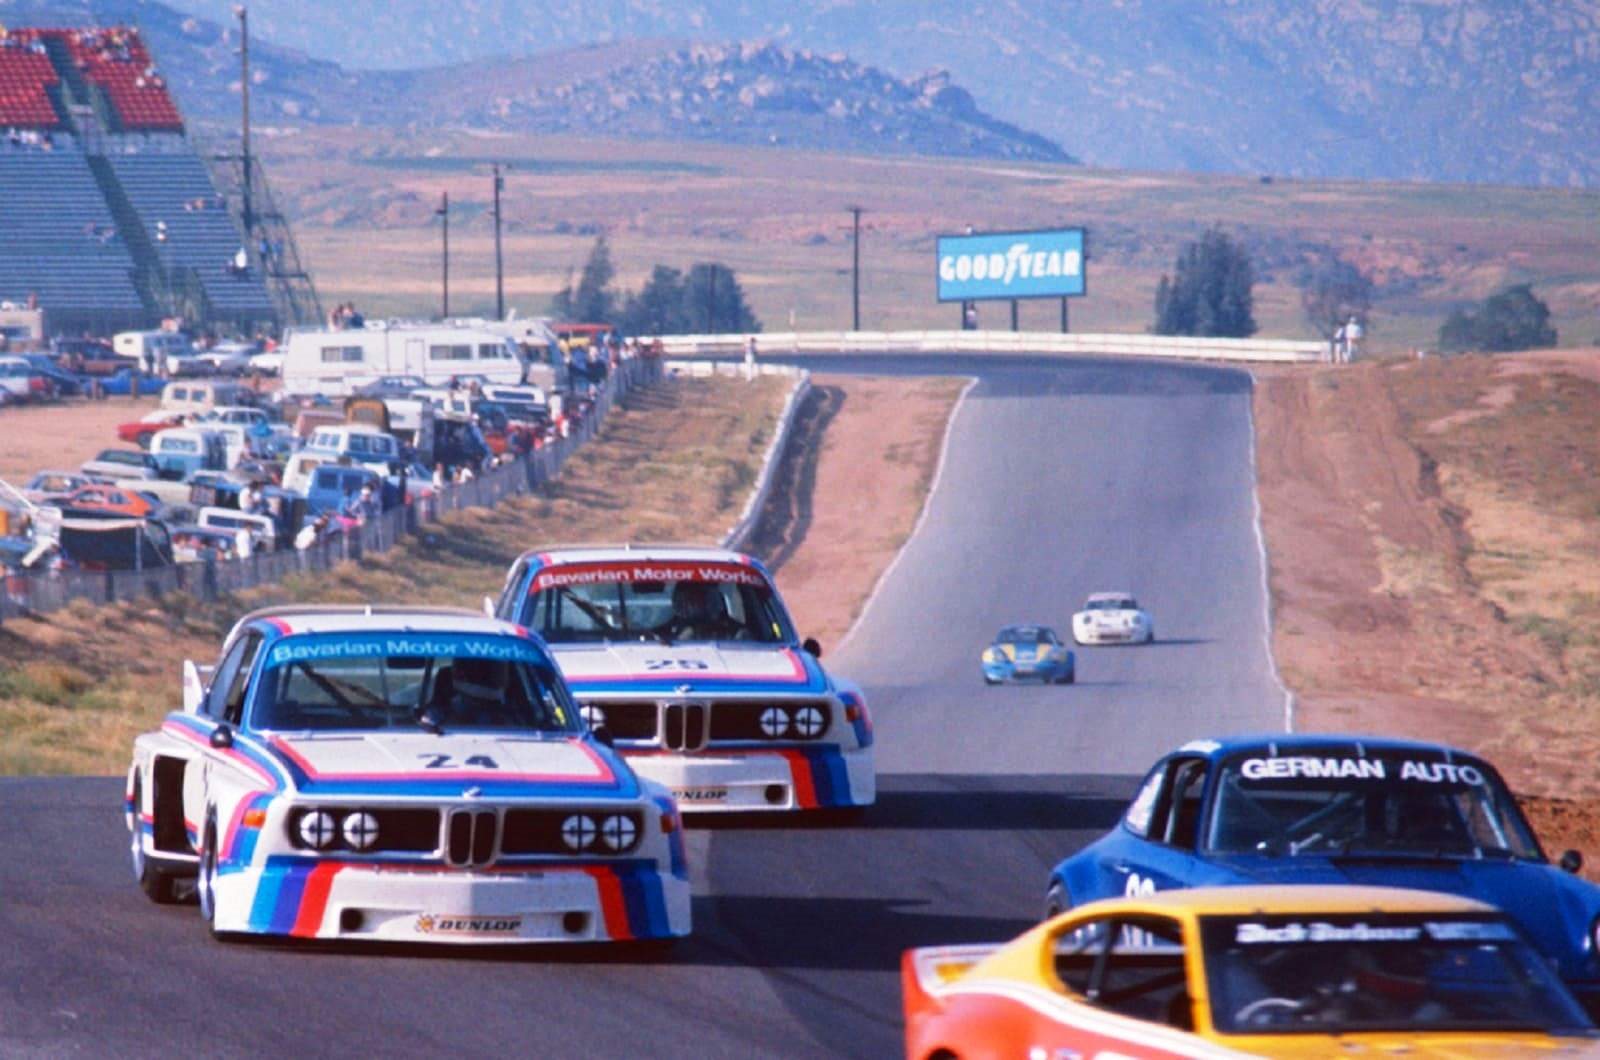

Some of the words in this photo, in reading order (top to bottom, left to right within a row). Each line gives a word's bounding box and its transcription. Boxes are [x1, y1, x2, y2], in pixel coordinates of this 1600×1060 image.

[939, 243, 1081, 285] GOODYEAR
[538, 567, 630, 588] Bavarian
[634, 566, 695, 582] Motor
[274, 640, 382, 662] Bavarian
[386, 640, 458, 656] Motor
[645, 658, 709, 671] 25
[416, 753, 499, 769] 24
[1241, 757, 1386, 780] GERMAN
[1401, 761, 1484, 786] AUTO
[438, 919, 523, 932] DUNLOP
